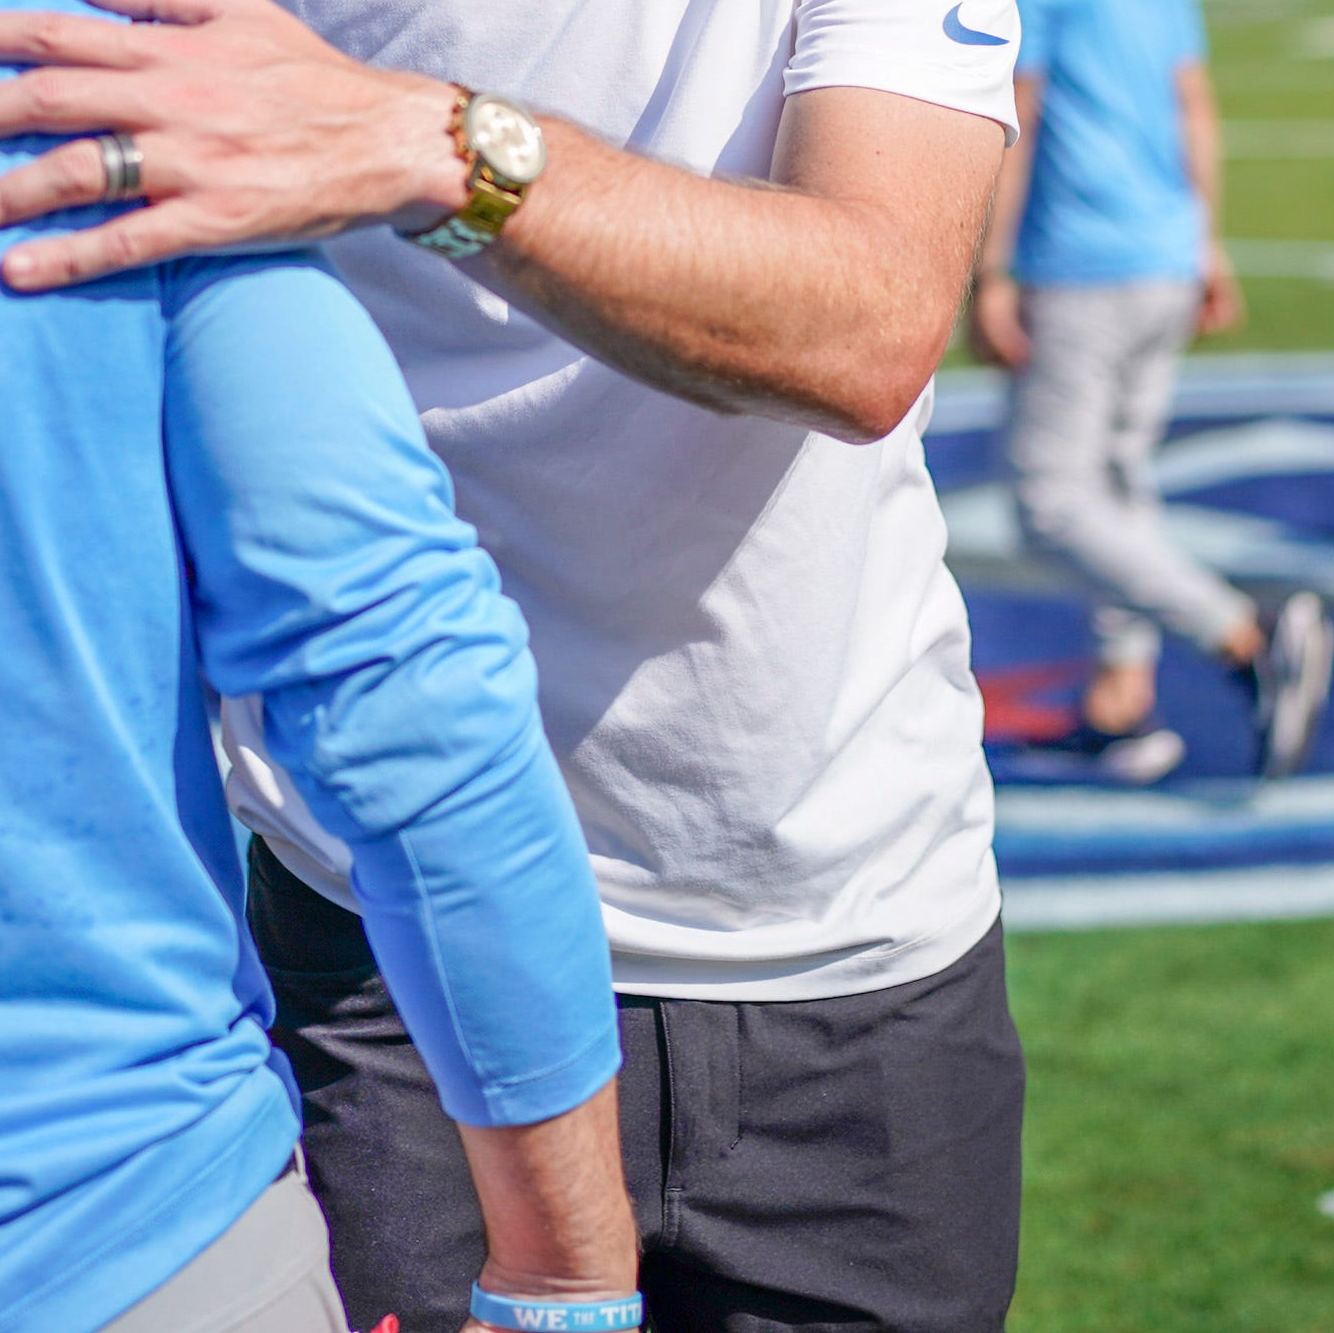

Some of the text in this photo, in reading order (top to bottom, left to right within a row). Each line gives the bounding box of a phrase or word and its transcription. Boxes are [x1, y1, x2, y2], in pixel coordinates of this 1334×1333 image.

[513, 1303, 642, 1331] WE THE TIT
